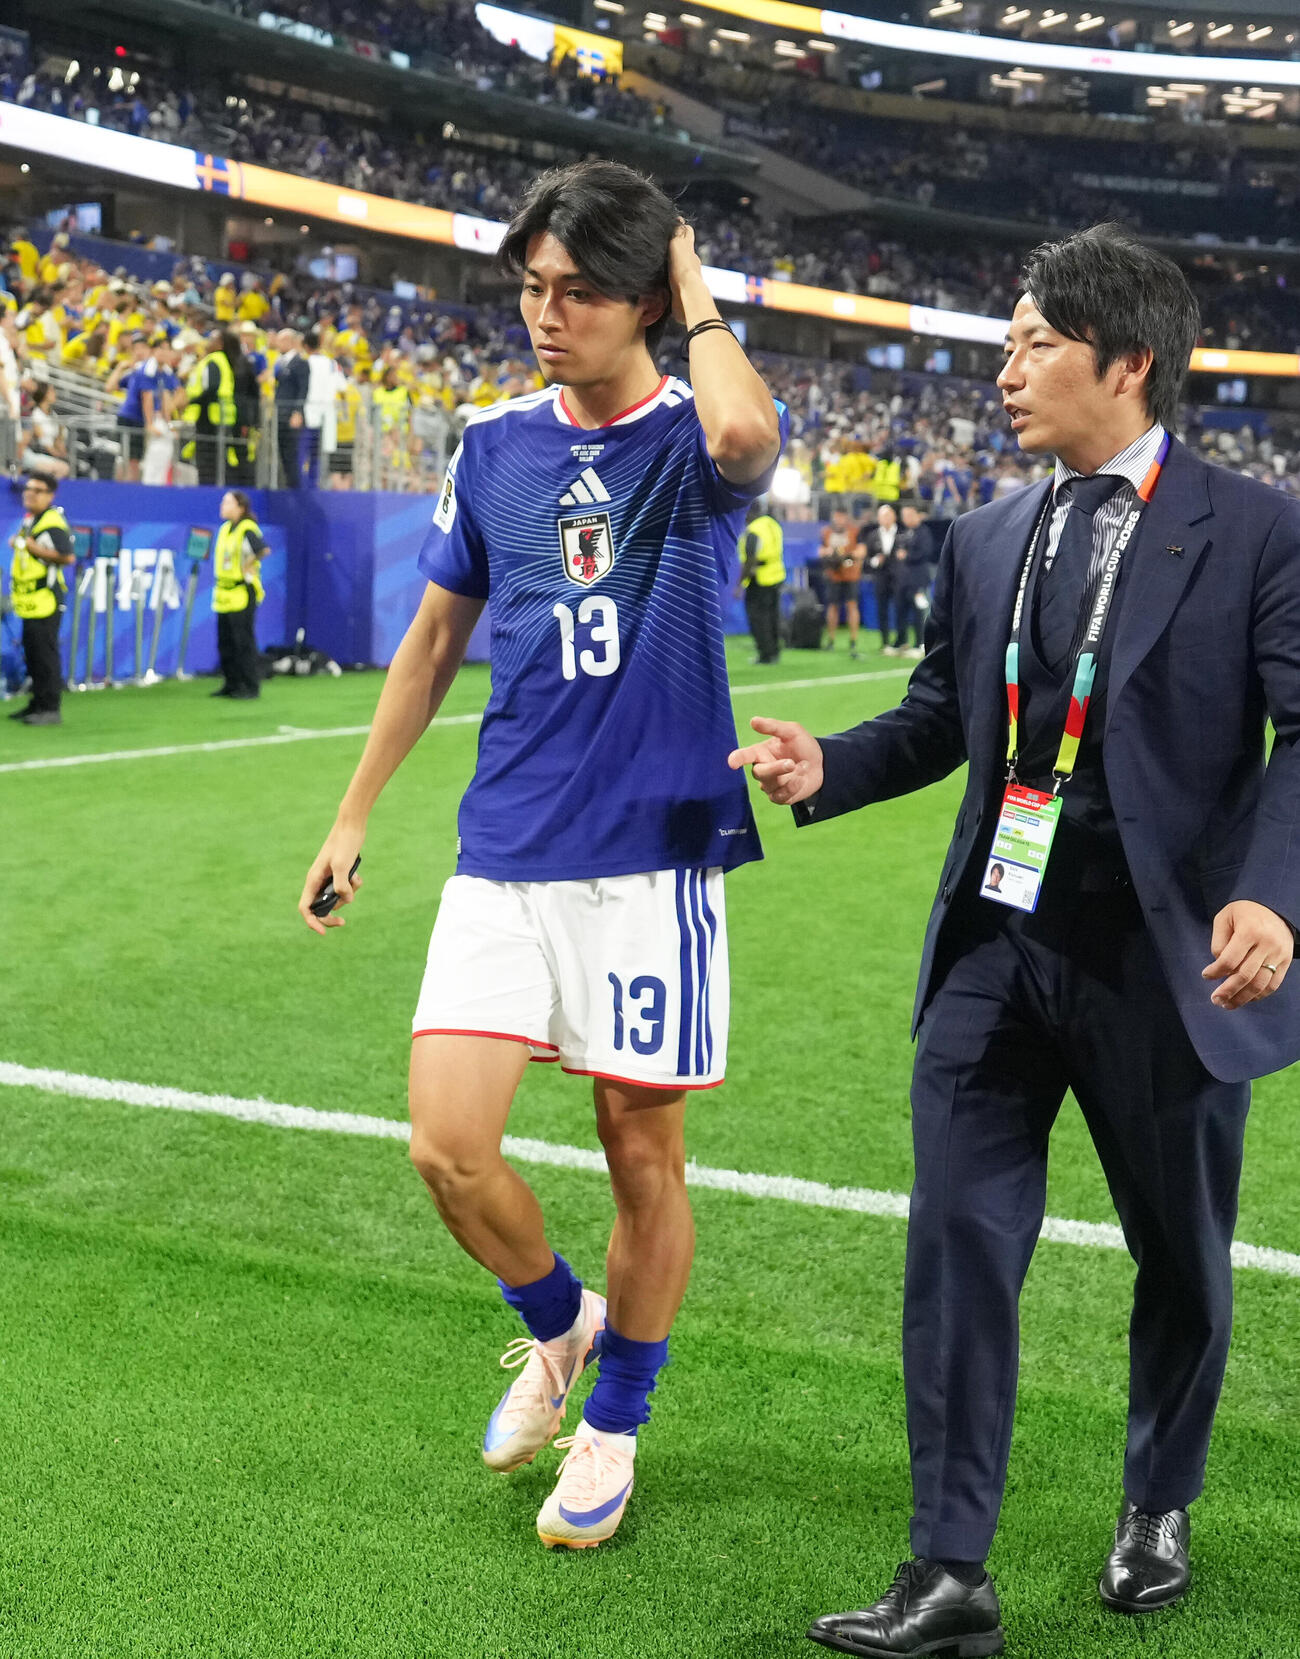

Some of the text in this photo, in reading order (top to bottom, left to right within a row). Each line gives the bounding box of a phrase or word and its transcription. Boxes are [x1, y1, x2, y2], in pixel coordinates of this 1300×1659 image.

[572, 517, 598, 527] JAPAN
[579, 564, 600, 577] JFA
[1088, 510, 1141, 642] FIFA WORLD CUP 2026
[553, 595, 621, 681] 13
[608, 971, 667, 1056] 13
